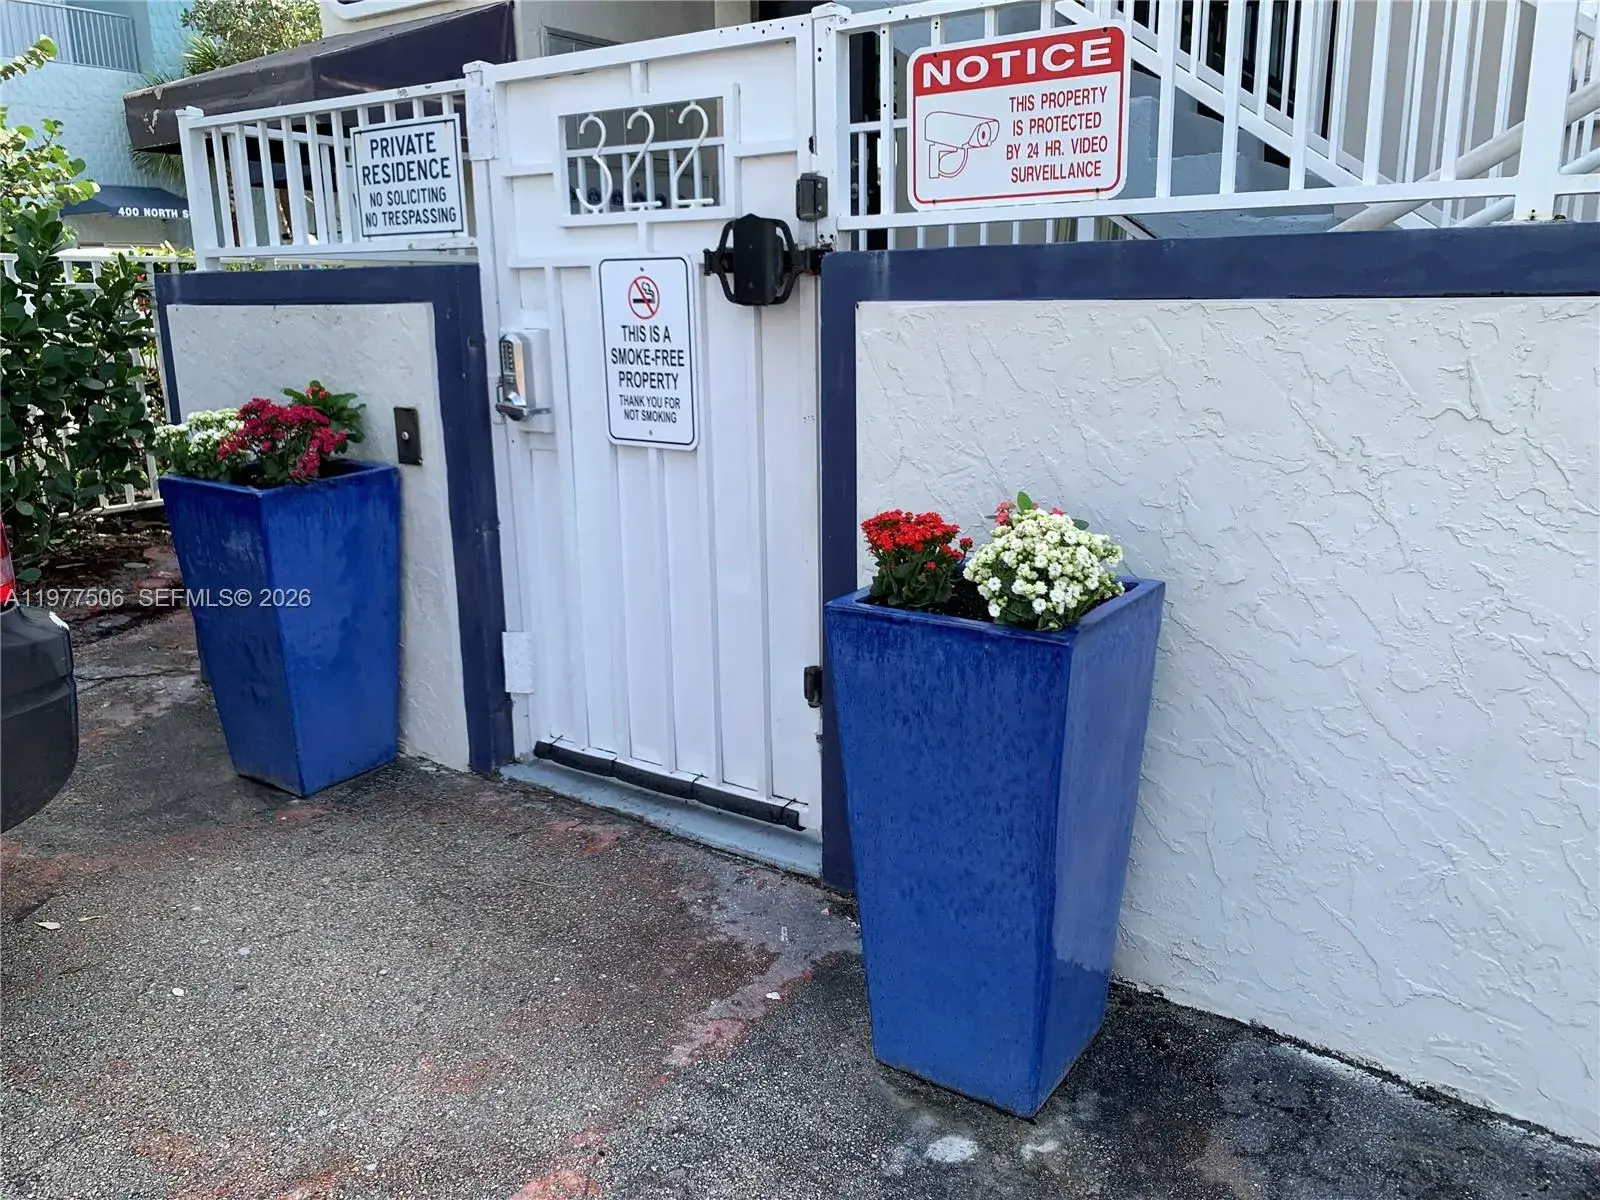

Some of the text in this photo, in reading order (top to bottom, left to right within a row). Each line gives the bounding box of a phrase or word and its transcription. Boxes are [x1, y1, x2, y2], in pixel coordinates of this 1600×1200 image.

[923, 37, 1112, 88] NOTICE
[1009, 86, 1107, 113] THIS PROPERTY
[1013, 112, 1101, 136] IS PROTECTED
[370, 131, 436, 159] PRIVATE
[1006, 136, 1108, 160] BY 24 HR. VIDEO
[575, 102, 714, 213] 322
[362, 157, 451, 186] RESIDENCE
[1011, 160, 1101, 183] SURVEILLANCE
[370, 186, 446, 207] NO SOLICITING
[118, 207, 139, 216] 400
[144, 208, 178, 218] NORTH
[365, 207, 456, 228] NO TRESPASSING
[622, 325, 671, 343] THIS IS A
[611, 348, 685, 367] SMOKE-FREE
[619, 371, 679, 390] PROPERTY
[619, 394, 680, 409] THANK YOU FOR
[624, 409, 677, 423] NOT SMOKING
